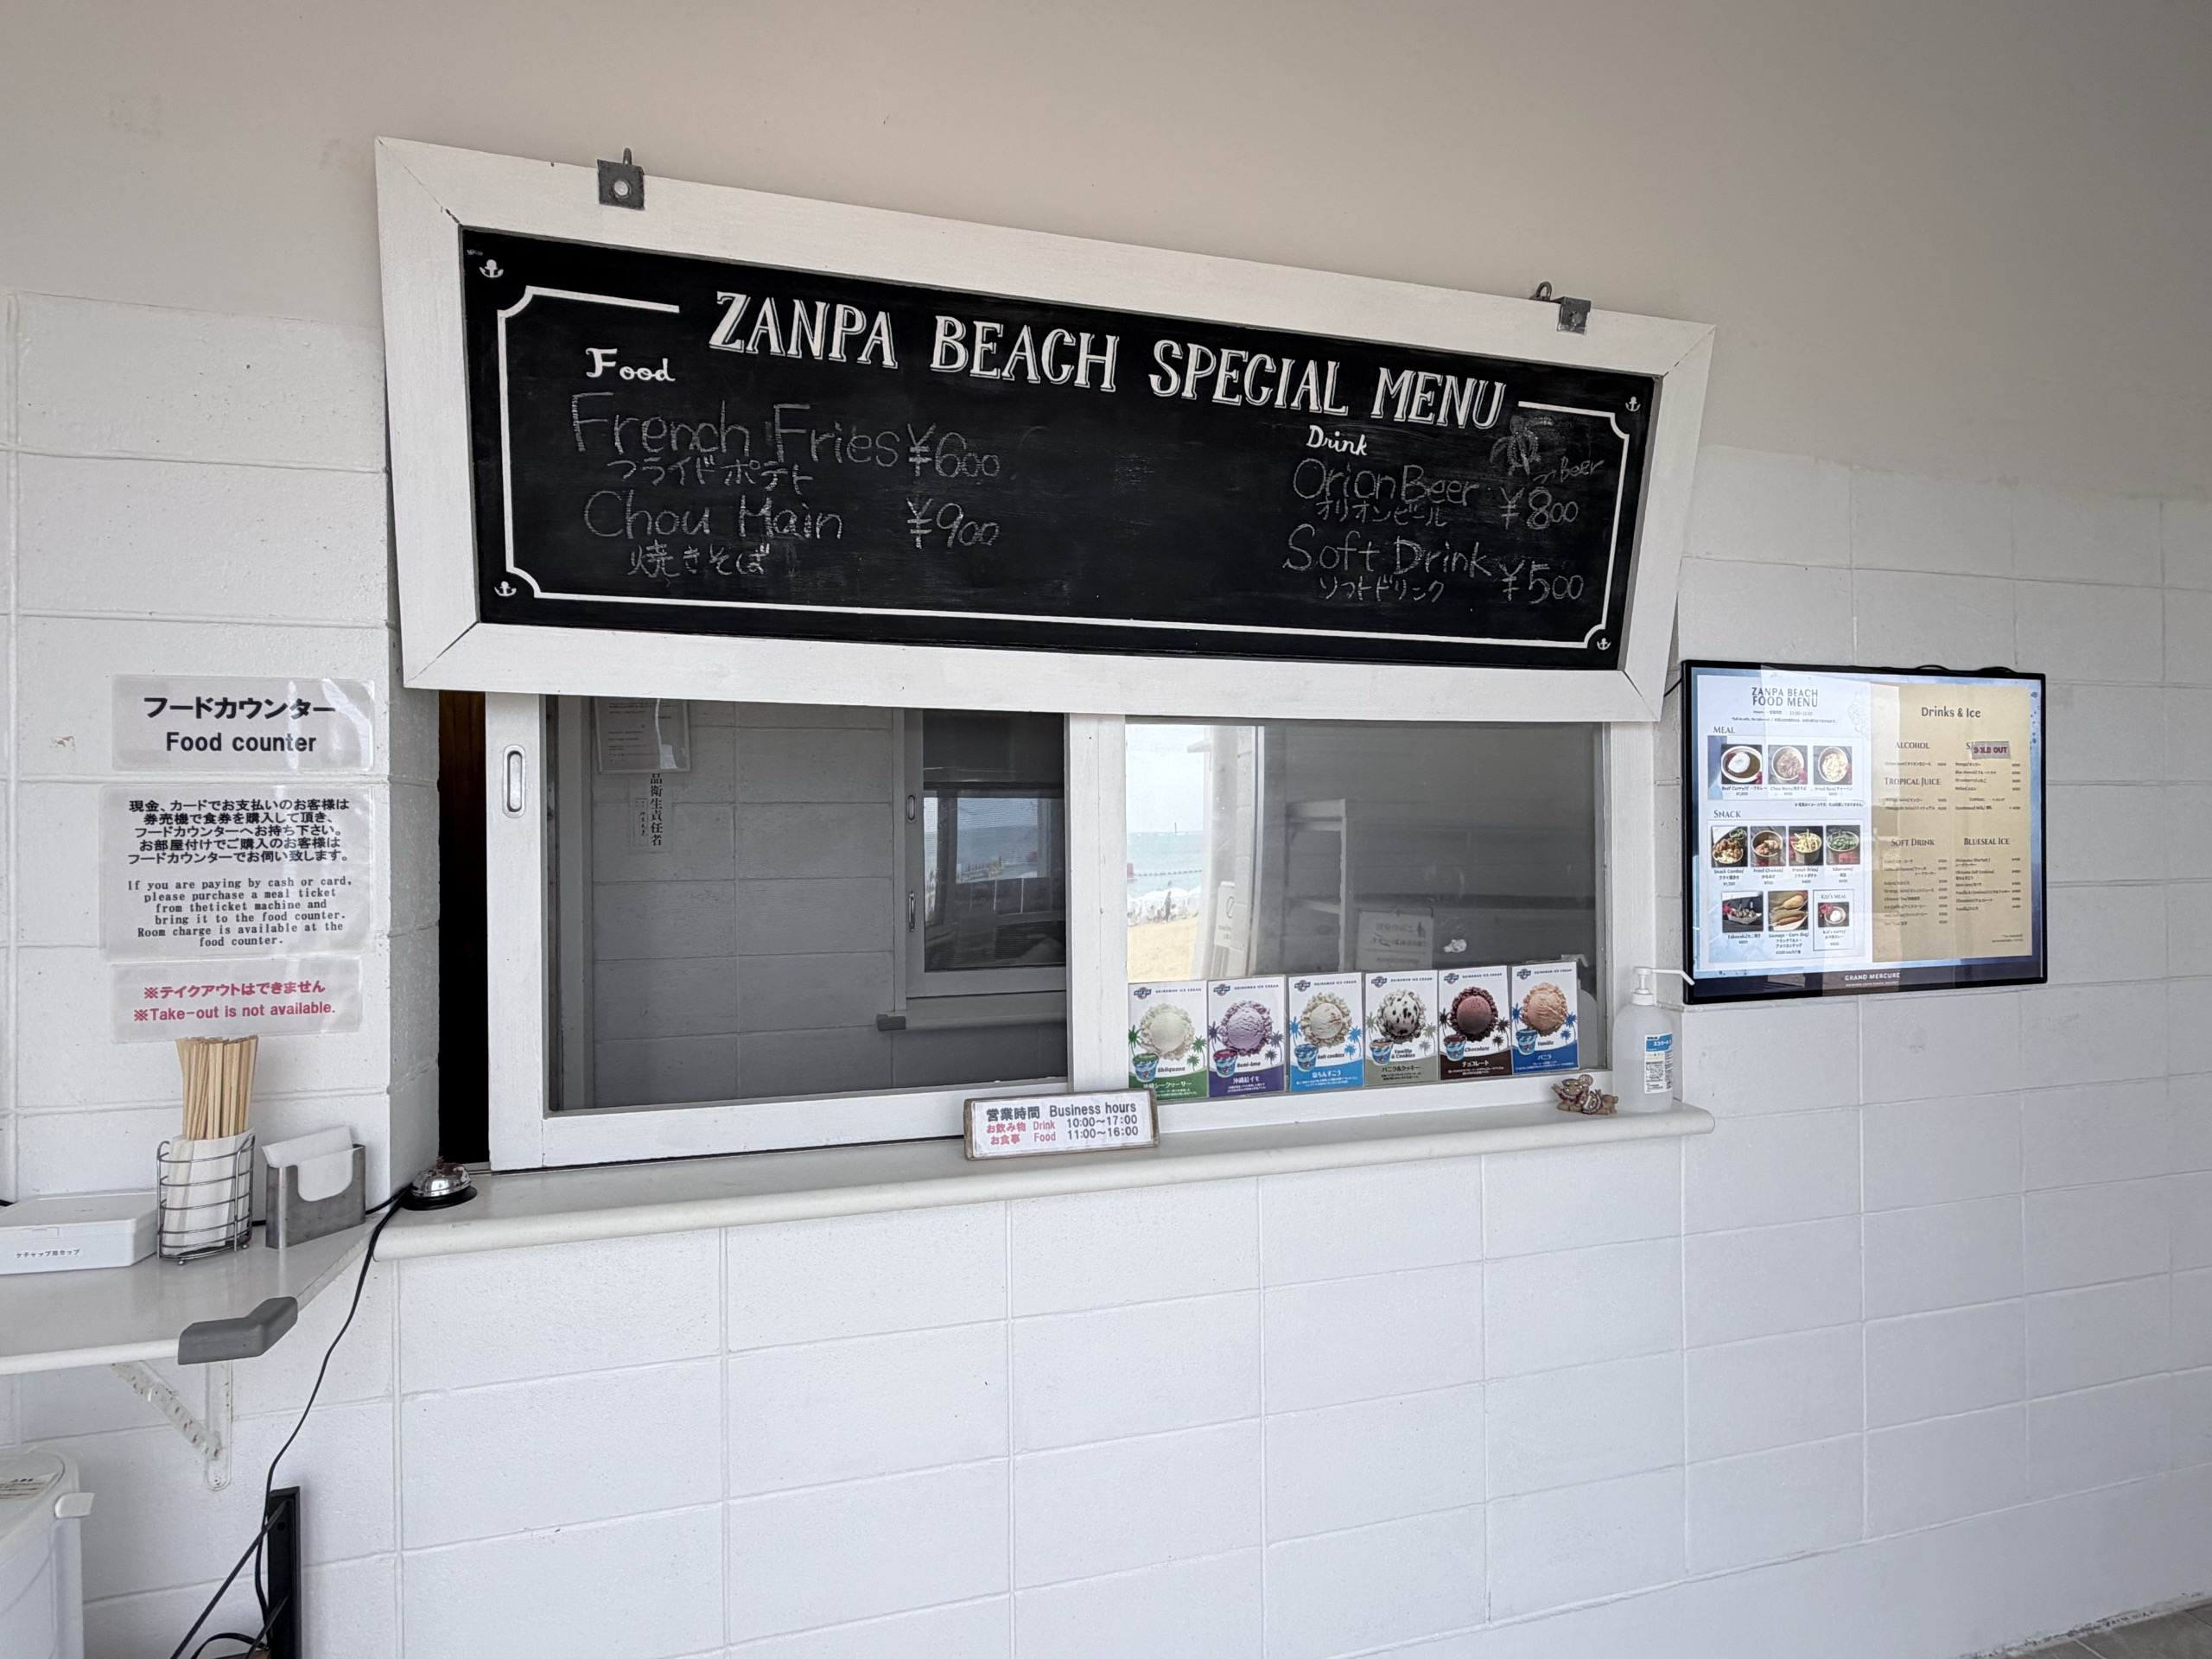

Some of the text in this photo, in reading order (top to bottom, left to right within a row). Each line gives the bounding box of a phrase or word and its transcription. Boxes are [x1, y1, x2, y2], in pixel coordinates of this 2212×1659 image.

[585, 347, 676, 381] Food
[709, 290, 1507, 429] ZANPA BEACH SPECIAL MENU
[571, 391, 1000, 477] French Fries ¥600
[1306, 424, 1368, 456] Drink
[607, 454, 814, 495] フライドポテト
[1293, 458, 1579, 530] Orion Beer ¥800
[1315, 499, 1448, 527] オリオンビール
[906, 498, 1000, 549] ¥900
[627, 539, 770, 578] 焼きそば
[1282, 523, 1584, 604] Soft Drink ¥500
[1751, 687, 1818, 697] ZANPA BEACH
[143, 696, 336, 720] フードカウンター
[1752, 696, 1818, 707] FOOD MENU
[1921, 706, 1981, 718] Drinks & Ice
[166, 732, 317, 752] Food counter
[1922, 778, 1941, 786] JUICE
[129, 798, 350, 812] 現金、カードでお支払いのお客様は
[143, 811, 334, 825] 券売機で食券を購入して頂き、
[135, 824, 341, 838] フードカウンターへお持ち下さい。
[139, 837, 340, 852] お部屋付けでご購入のお客様は
[1891, 838, 1935, 848] SOFT DRINK
[1963, 837, 1997, 846] BLUESEAL
[128, 850, 348, 864] フードカウンターでお伺い致します。
[128, 876, 353, 891] If you are paying by cash or card,
[144, 891, 185, 903] please
[192, 891, 245, 902] purchase
[264, 888, 290, 899] meal
[299, 888, 336, 898] ticket
[156, 899, 327, 913] from theticket machine and
[155, 911, 346, 925] bring it to the food counter.
[137, 921, 344, 938] Room charge is available at the
[199, 936, 283, 947] food counter.
[144, 980, 326, 999] ※テイクアウトはできません
[225, 1005, 237, 1018] is
[242, 1003, 264, 1017] not
[270, 1001, 336, 1016] available.
[986, 1102, 1137, 1122] 営業時間 Business hours
[986, 1122, 1027, 1134] お飲み物
[1033, 1121, 1056, 1130] Drink
[990, 1134, 1020, 1145] お食事
[1033, 1131, 1057, 1142] Food
